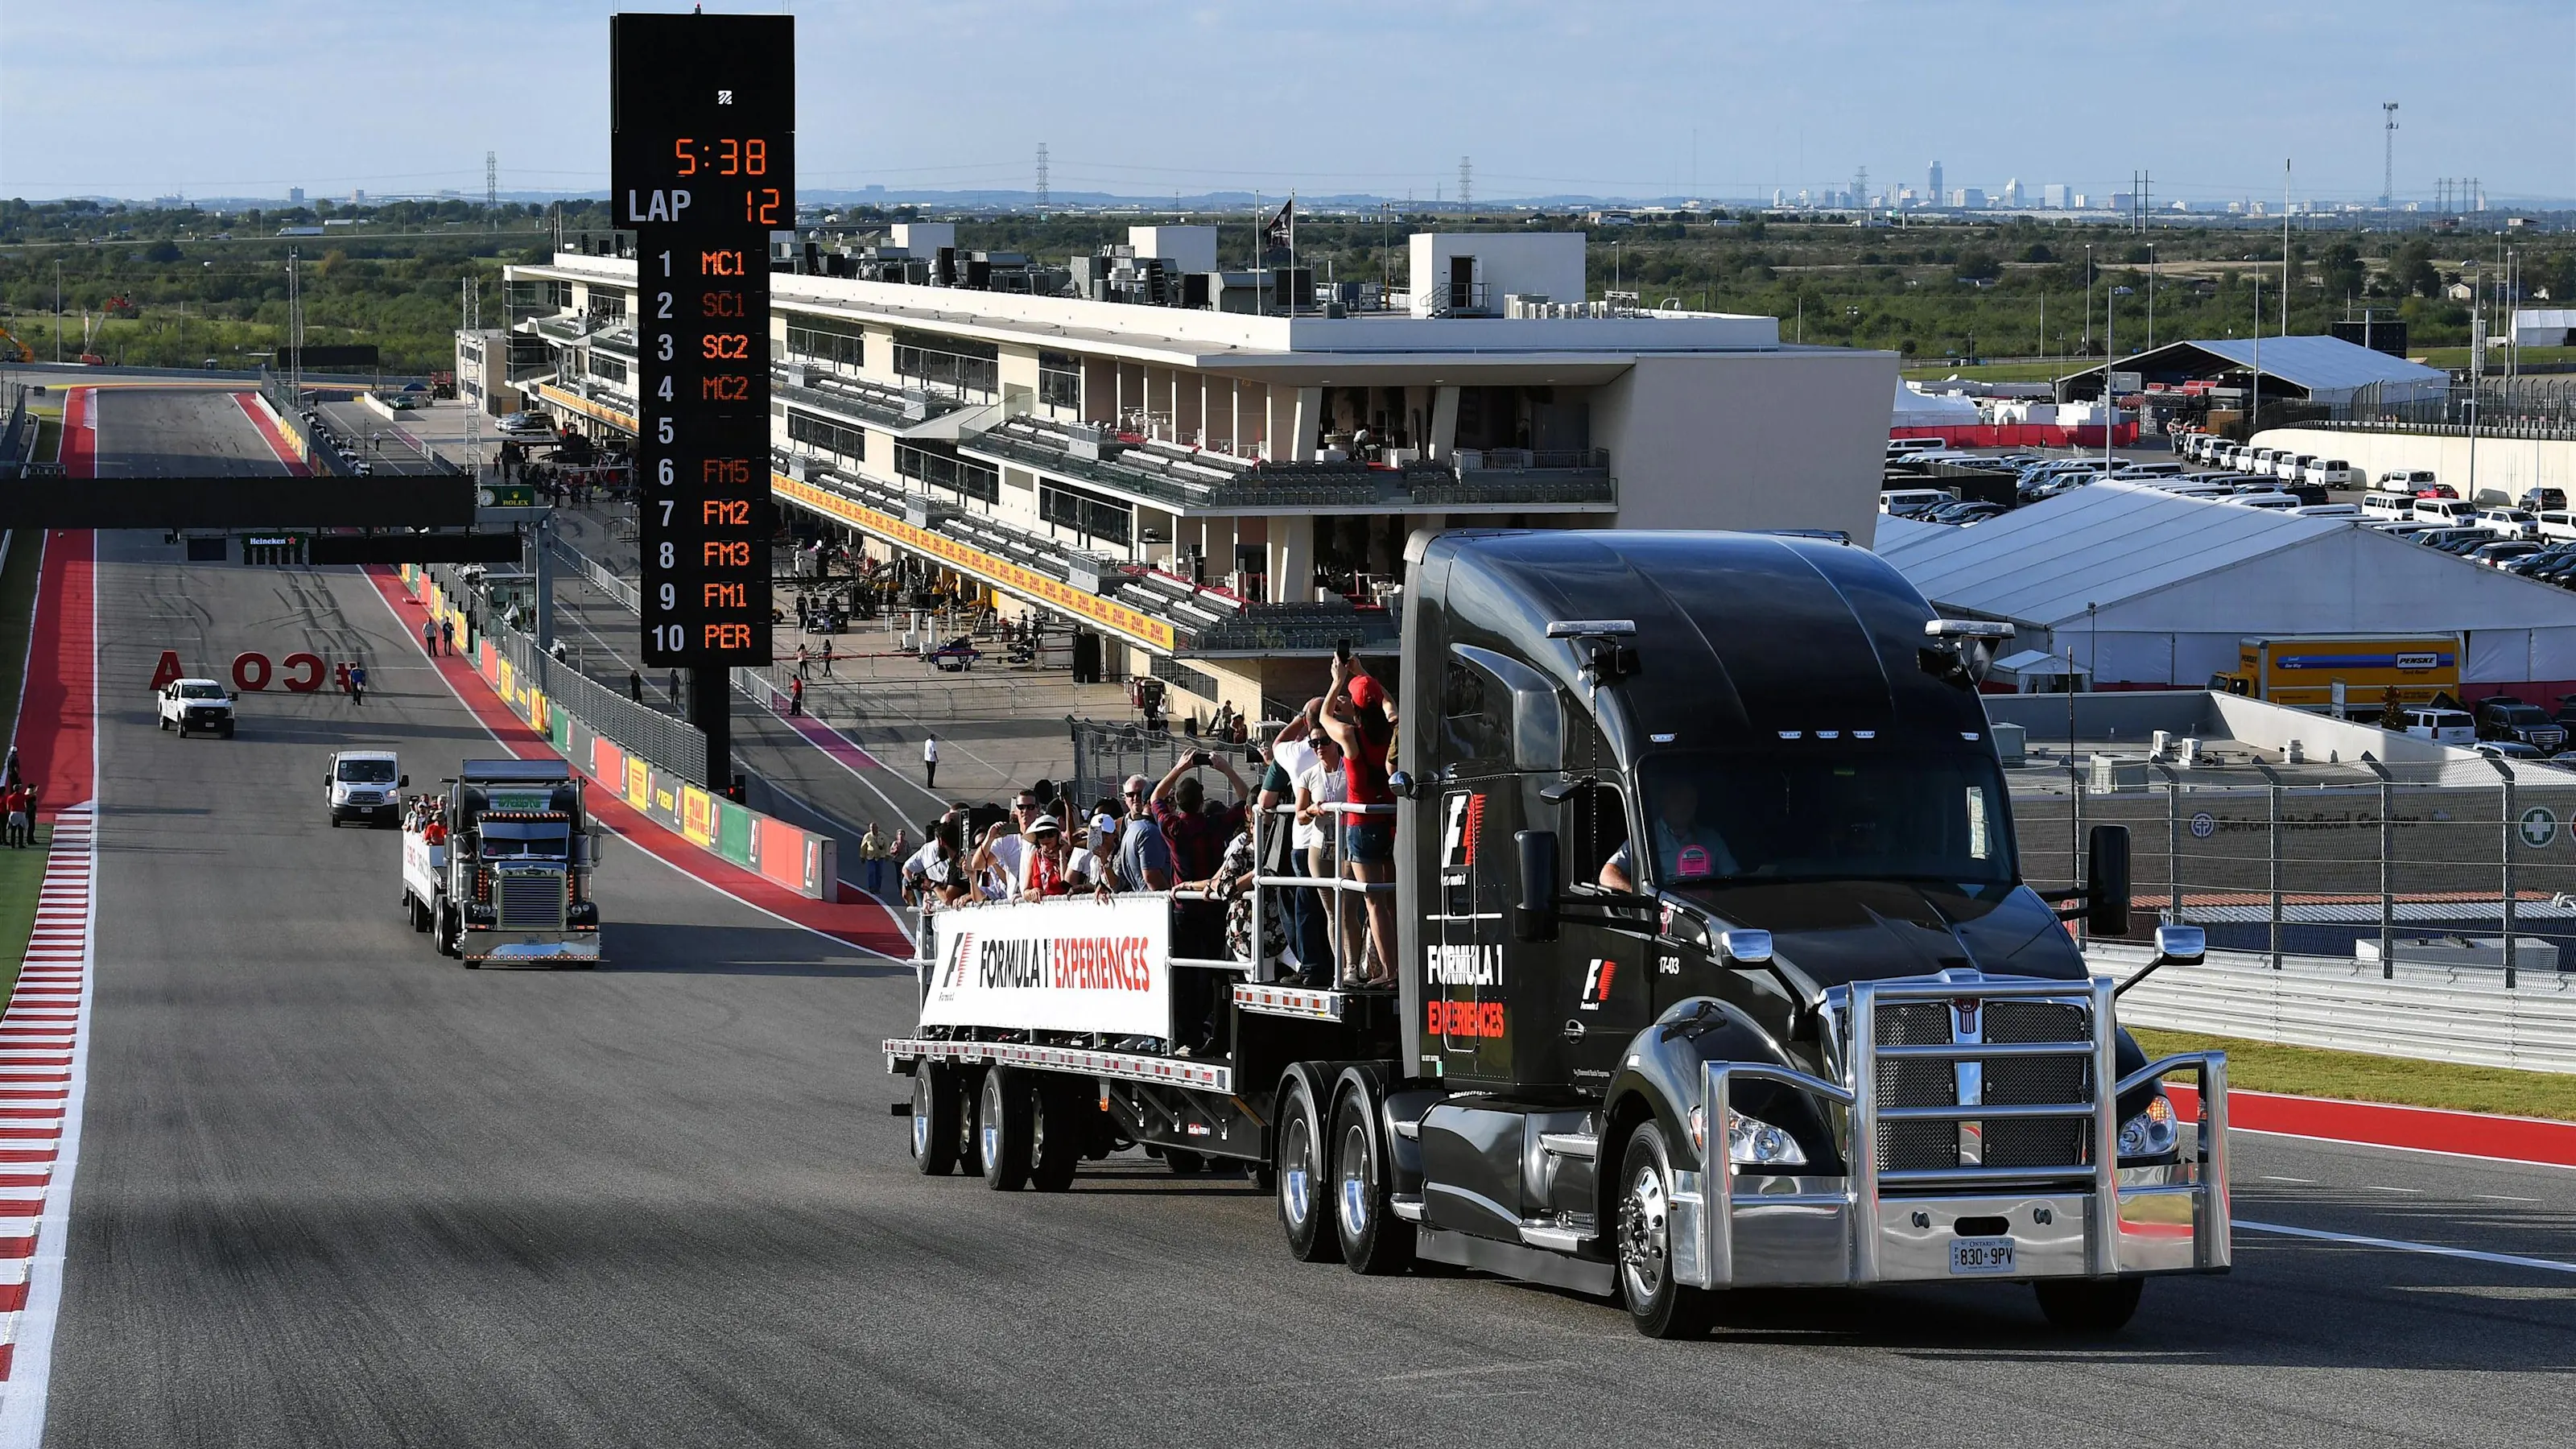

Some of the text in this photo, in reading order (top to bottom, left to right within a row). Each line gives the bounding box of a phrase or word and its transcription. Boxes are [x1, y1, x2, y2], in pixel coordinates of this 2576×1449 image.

[676, 138, 766, 175] 5:38
[629, 188, 779, 225] LAP 12
[658, 250, 745, 277] 1 MC1
[657, 291, 745, 319] 2 SC1
[658, 334, 748, 361] 3 SC2
[658, 375, 749, 402] 4 MC2
[658, 417, 674, 444] 5
[658, 458, 749, 486] 6 FM5
[658, 500, 749, 526] 7 FM2
[250, 537, 286, 545] Heineken
[659, 542, 750, 568] 8 FM3
[659, 583, 747, 610] 9 FM1
[651, 624, 750, 651] 10 PER
[980, 939, 1040, 989] FORMULA
[1055, 936, 1150, 992] EXPERIENCES
[1427, 944, 1503, 985] FORMULA 1
[1659, 956, 1680, 974] 17-03
[1428, 1001, 1504, 1038] EXPERIENCES
[1960, 1249, 1983, 1265] 830
[1991, 1248, 2013, 1265] 9PV
